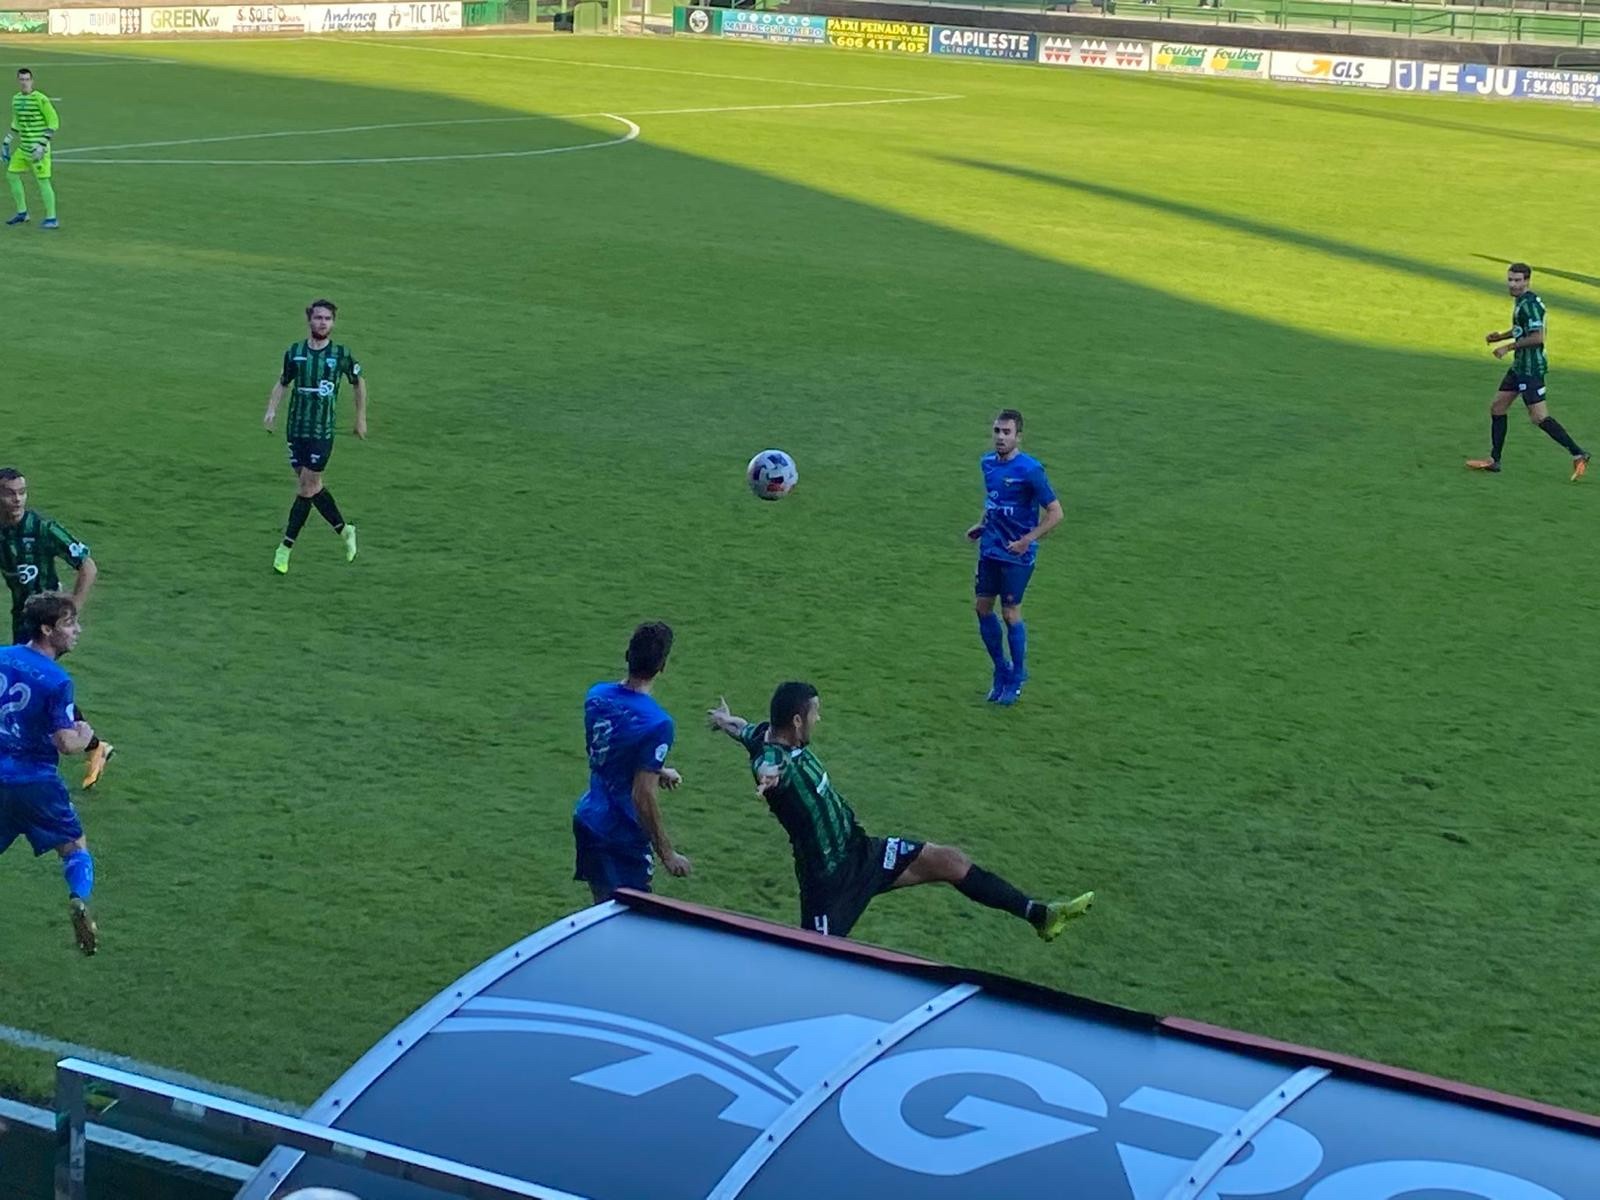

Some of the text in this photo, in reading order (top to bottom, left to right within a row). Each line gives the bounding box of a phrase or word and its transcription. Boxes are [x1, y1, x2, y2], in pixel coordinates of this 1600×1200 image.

[409, 3, 427, 24] TIC
[430, 3, 450, 23] TAC
[827, 19, 859, 31] PATXI
[837, 36, 864, 48] 606
[867, 39, 893, 50] 411
[898, 41, 926, 53] 405
[939, 29, 1030, 51] CAPILESTE
[1332, 61, 1365, 79] GLS
[1526, 70, 1561, 81] COCINA
[1533, 80, 1548, 93] 94
[1549, 81, 1570, 95] 496
[1572, 82, 1587, 96] 05
